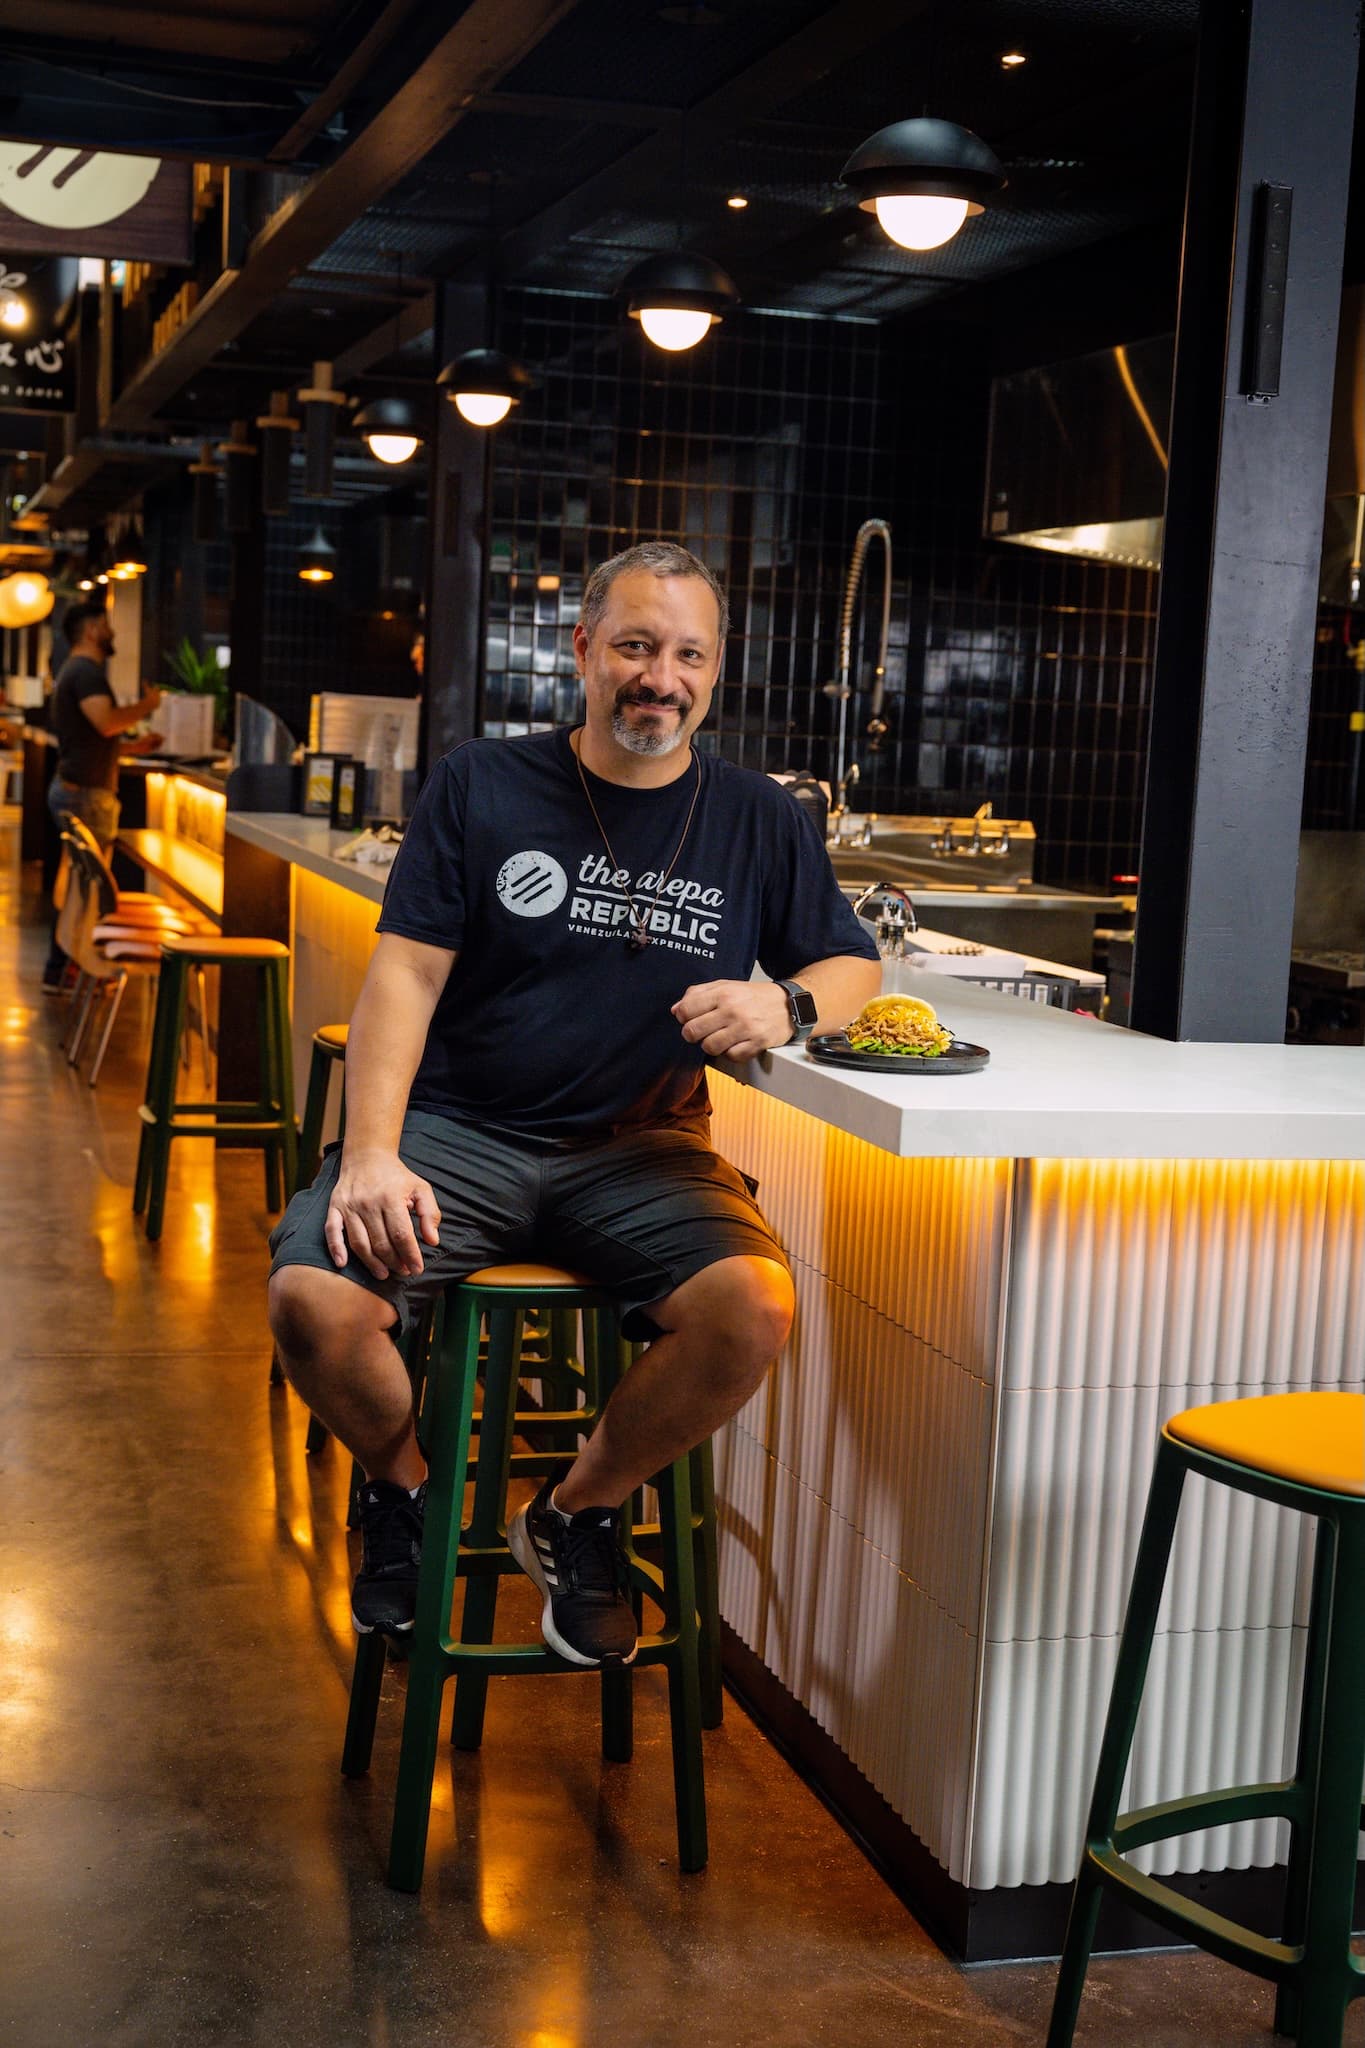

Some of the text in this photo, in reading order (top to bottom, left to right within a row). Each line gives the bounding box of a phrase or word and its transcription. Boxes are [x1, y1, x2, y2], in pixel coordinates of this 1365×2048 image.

[577, 854, 725, 909] the arepa
[569, 896, 720, 945] REPUBLIC
[646, 936, 715, 959] XPERIENCE
